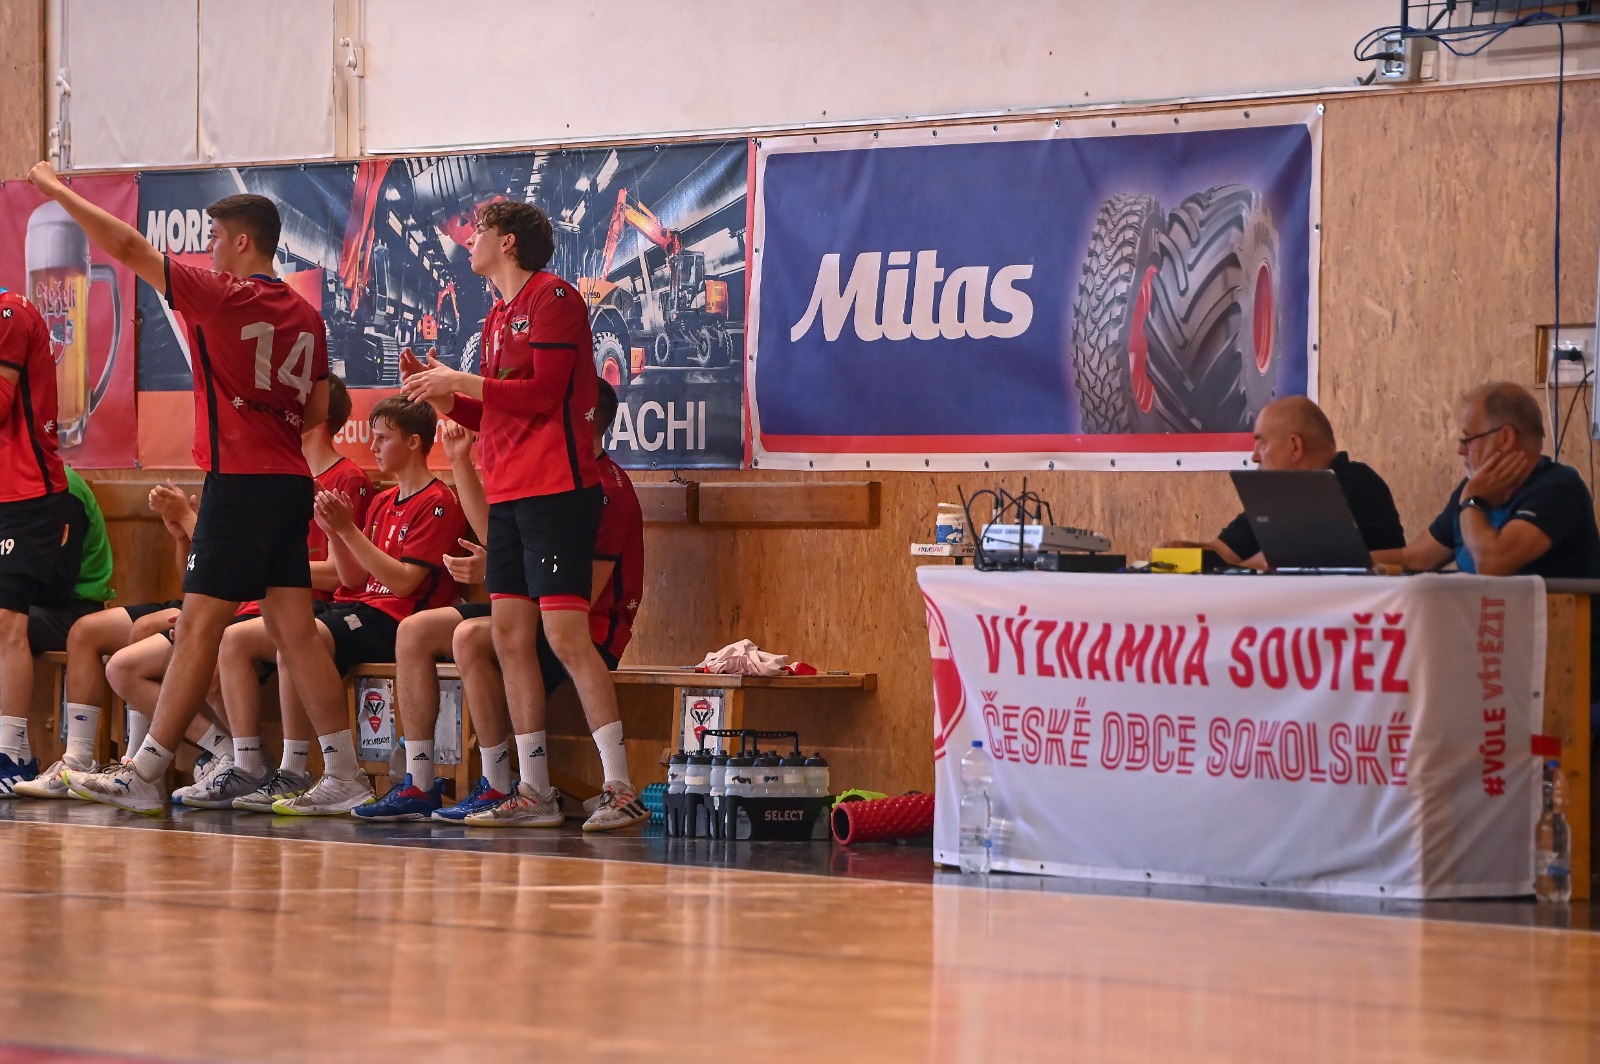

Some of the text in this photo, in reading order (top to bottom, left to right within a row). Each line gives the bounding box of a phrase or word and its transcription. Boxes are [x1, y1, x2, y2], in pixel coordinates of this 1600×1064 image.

[146, 208, 213, 253] MORE
[790, 250, 1034, 342] Mitas
[240, 321, 315, 406] 14
[602, 400, 706, 452] ACHI
[975, 604, 1410, 694] VÝZNAMNÁ SOUTĚŽ
[980, 690, 1413, 786] ČESKÉ OBCE SOKOLSKÉ
[1479, 707, 1507, 799] #VŮLE
[764, 810, 805, 821] SELECT
